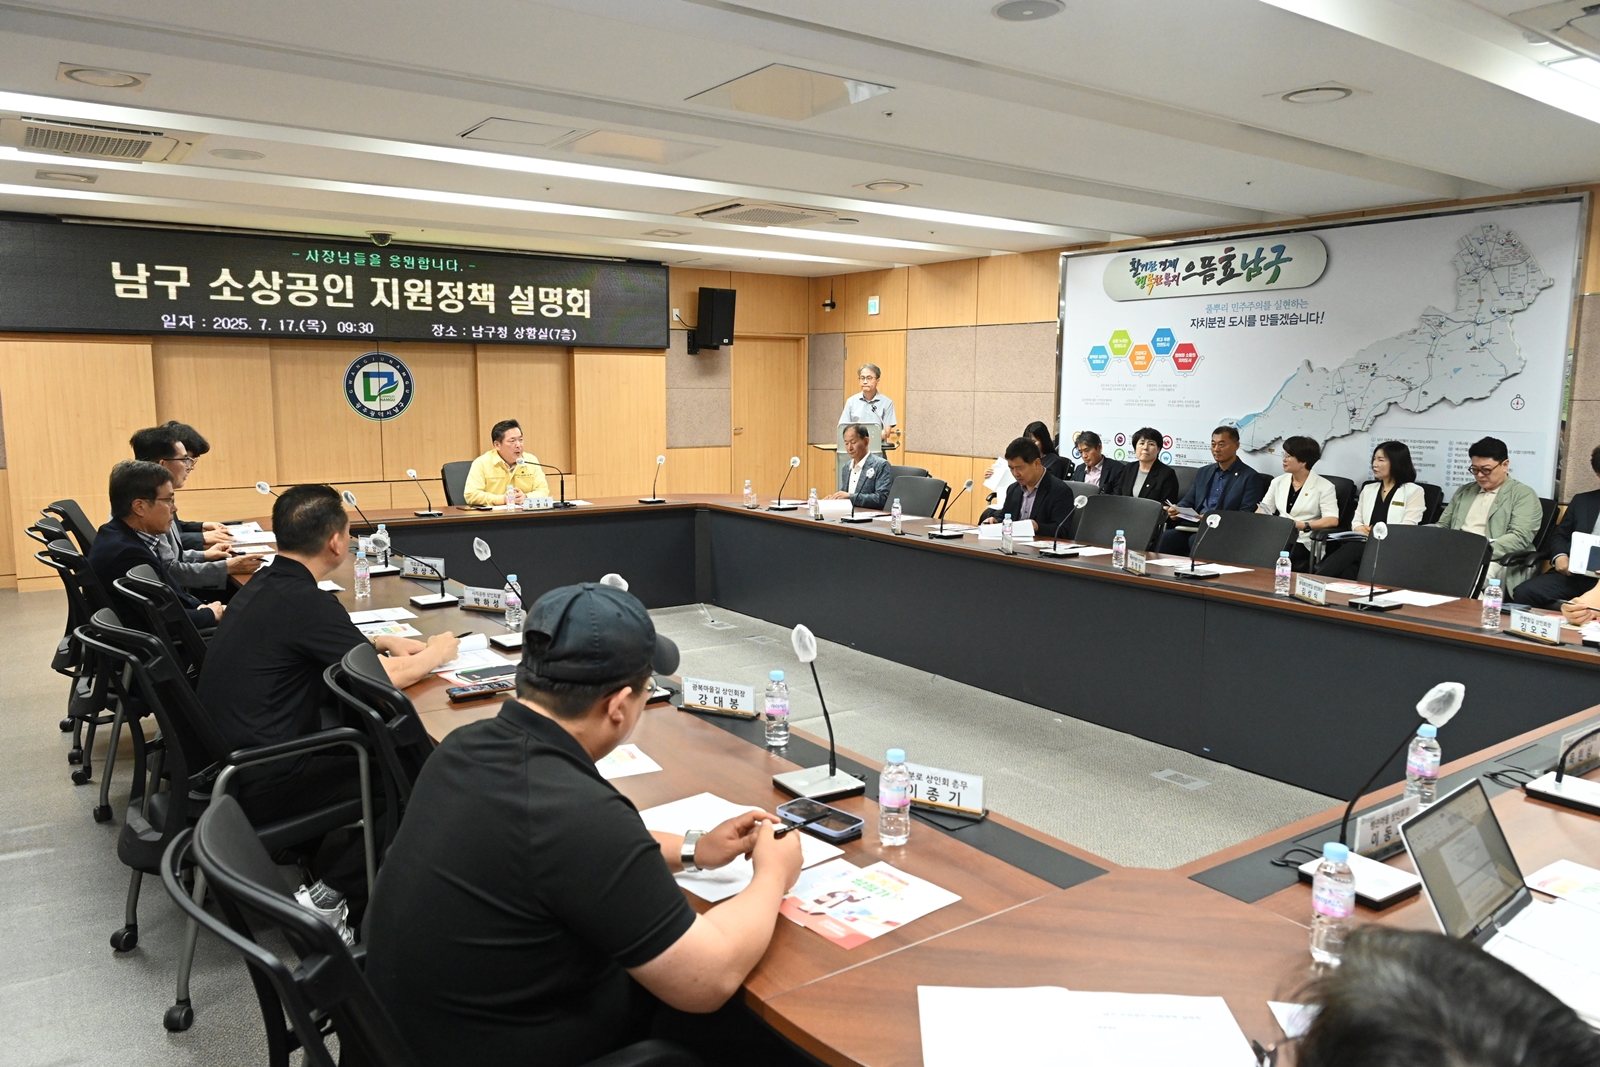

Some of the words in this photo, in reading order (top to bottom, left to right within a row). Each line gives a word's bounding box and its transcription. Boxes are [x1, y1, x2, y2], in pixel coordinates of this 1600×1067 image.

[305, 249, 381, 267] 사장님들을
[389, 254, 464, 272] 응원합니다.
[111, 261, 191, 300] 남구
[208, 268, 355, 308] 소상공인
[370, 277, 496, 314] 지원정책
[508, 284, 591, 319] 설명회
[1205, 303, 1229, 314] 풀뿌리
[1231, 300, 1271, 313] 민주주의를
[1274, 298, 1309, 310] 실현하는
[160, 313, 196, 329] 일자
[212, 316, 252, 331] 2025.
[258, 318, 272, 331] 7.
[279, 319, 327, 334] 17.(목)
[337, 321, 374, 334] 09:30
[1190, 316, 1226, 330] 자치분권
[1228, 314, 1257, 328] 도시를
[1260, 311, 1325, 327] 만들겠습니다!
[431, 323, 458, 337] 장소
[471, 325, 508, 339] 남구청
[513, 326, 578, 341] 상황실(7층)
[722, 688, 746, 698] 상인회장
[926, 775, 950, 787] 상인회
